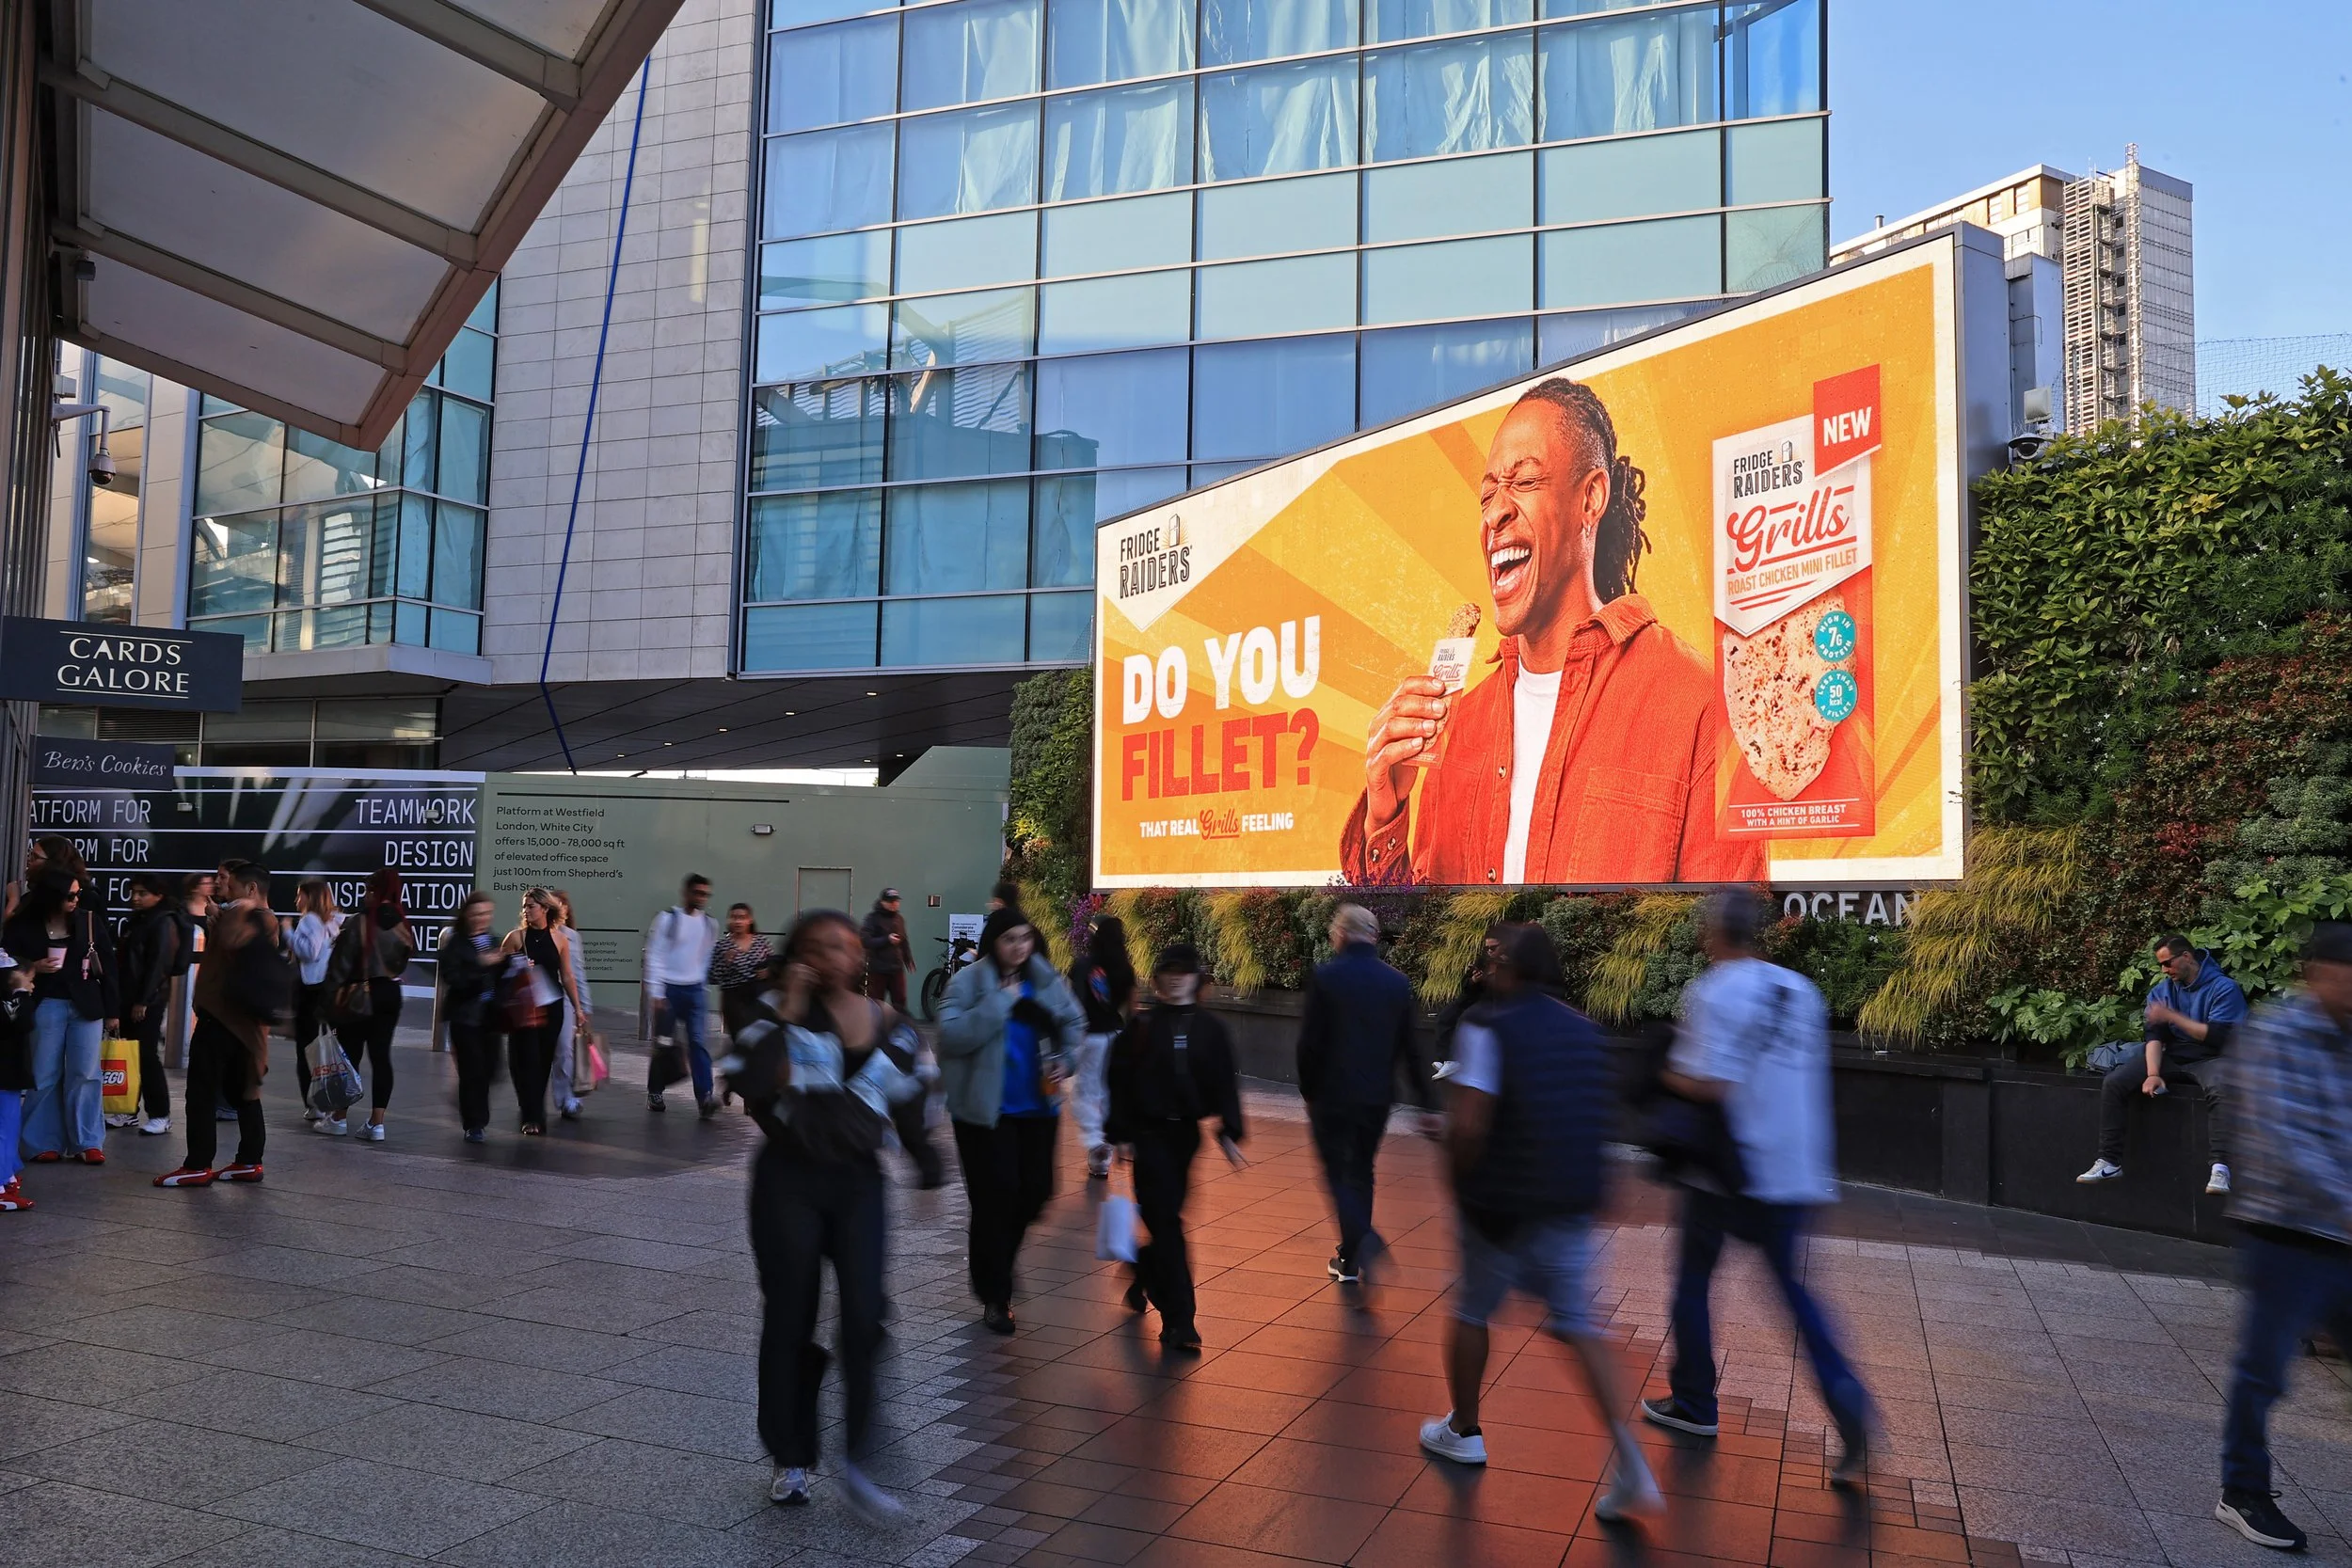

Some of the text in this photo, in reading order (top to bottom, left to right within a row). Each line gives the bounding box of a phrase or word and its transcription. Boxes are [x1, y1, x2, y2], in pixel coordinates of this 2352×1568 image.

[1823, 406, 1872, 448] NEW
[1733, 450, 1773, 475] FRIDGE
[1734, 461, 1803, 499] RAIDERS
[1726, 485, 1850, 573] Grills
[1120, 527, 1160, 562] FRIDGE
[1120, 546, 1190, 599] RAIDERS
[1727, 547, 1858, 596] ROAST CHICKEN MINI FILLET
[1820, 614, 1851, 633] HIGH IN
[69, 638, 182, 666] CARDS
[1819, 640, 1852, 658] PROTEIN
[57, 664, 190, 693] GALORE
[1122, 614, 1320, 725] DO YOU
[1818, 673, 1853, 695] LESS THAN
[1829, 684, 1842, 699] 50
[1827, 701, 1852, 718] FILLET
[43, 752, 167, 776] Ben's Cookies
[1121, 707, 1320, 801] FILLET?
[30, 800, 151, 824] ATFORM FOR
[355, 799, 476, 825] TEAMWORK
[496, 806, 541, 816] Platform
[555, 808, 605, 817] Westfield
[1741, 804, 1847, 818] 100% CHICKEN BREAST
[1747, 815, 1840, 827] WITH A HINT OF GARLIC
[496, 822, 594, 833] London, White City
[1139, 808, 1295, 840] THAT REAL Grills FEELING
[110, 838, 149, 863] FOR
[384, 841, 473, 867] DESIGN
[495, 837, 525, 846] offers
[527, 837, 560, 847] 15,000
[567, 838, 602, 848] 78,000
[603, 841, 615, 849] sq
[616, 839, 625, 848] ft
[494, 852, 505, 861] of
[506, 852, 548, 862] elevated
[549, 853, 578, 863] office
[493, 866, 623, 879] just 100m from Shepherd's
[108, 878, 132, 902] FO
[327, 881, 470, 910] NSPATION
[493, 882, 517, 892] Bush
[103, 1071, 125, 1085] EGO
